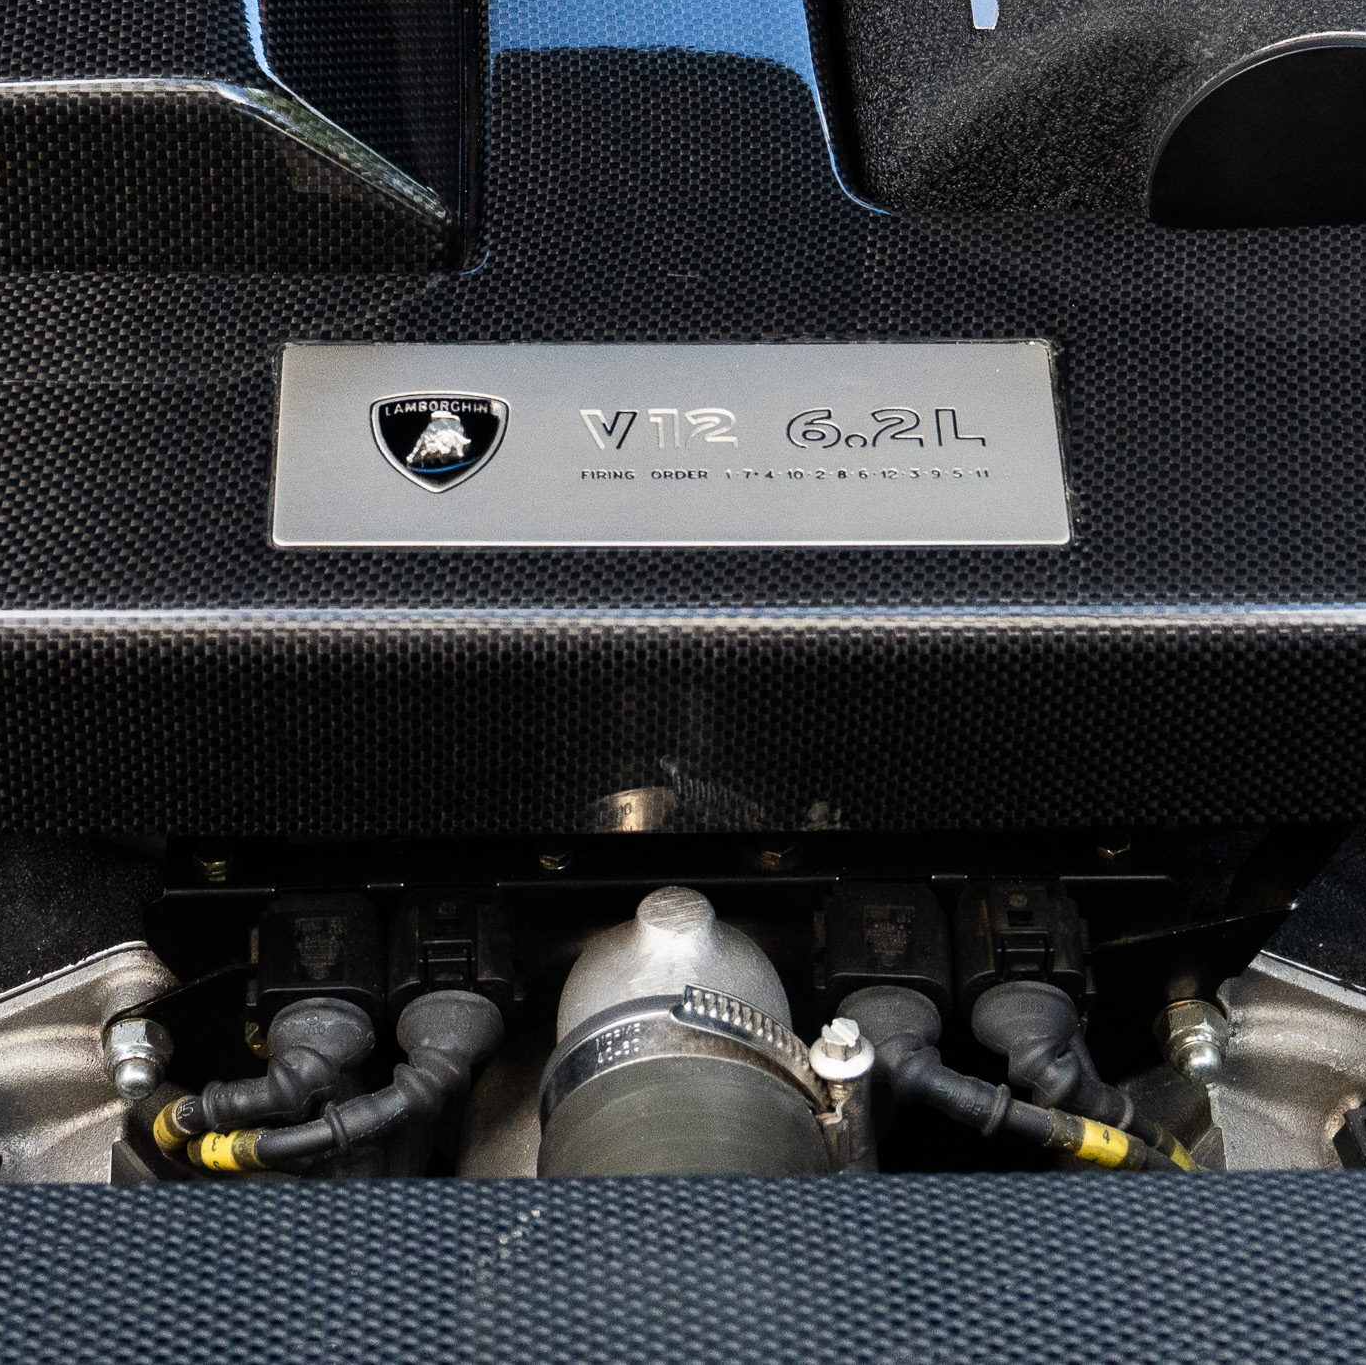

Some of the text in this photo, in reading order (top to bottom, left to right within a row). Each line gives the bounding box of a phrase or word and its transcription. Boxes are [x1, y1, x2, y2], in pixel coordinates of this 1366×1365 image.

[579, 407, 987, 450] V12 6.2L
[581, 469, 635, 481] FIRING
[650, 469, 709, 481] ORDER
[1102, 1129, 1111, 1145] 4
